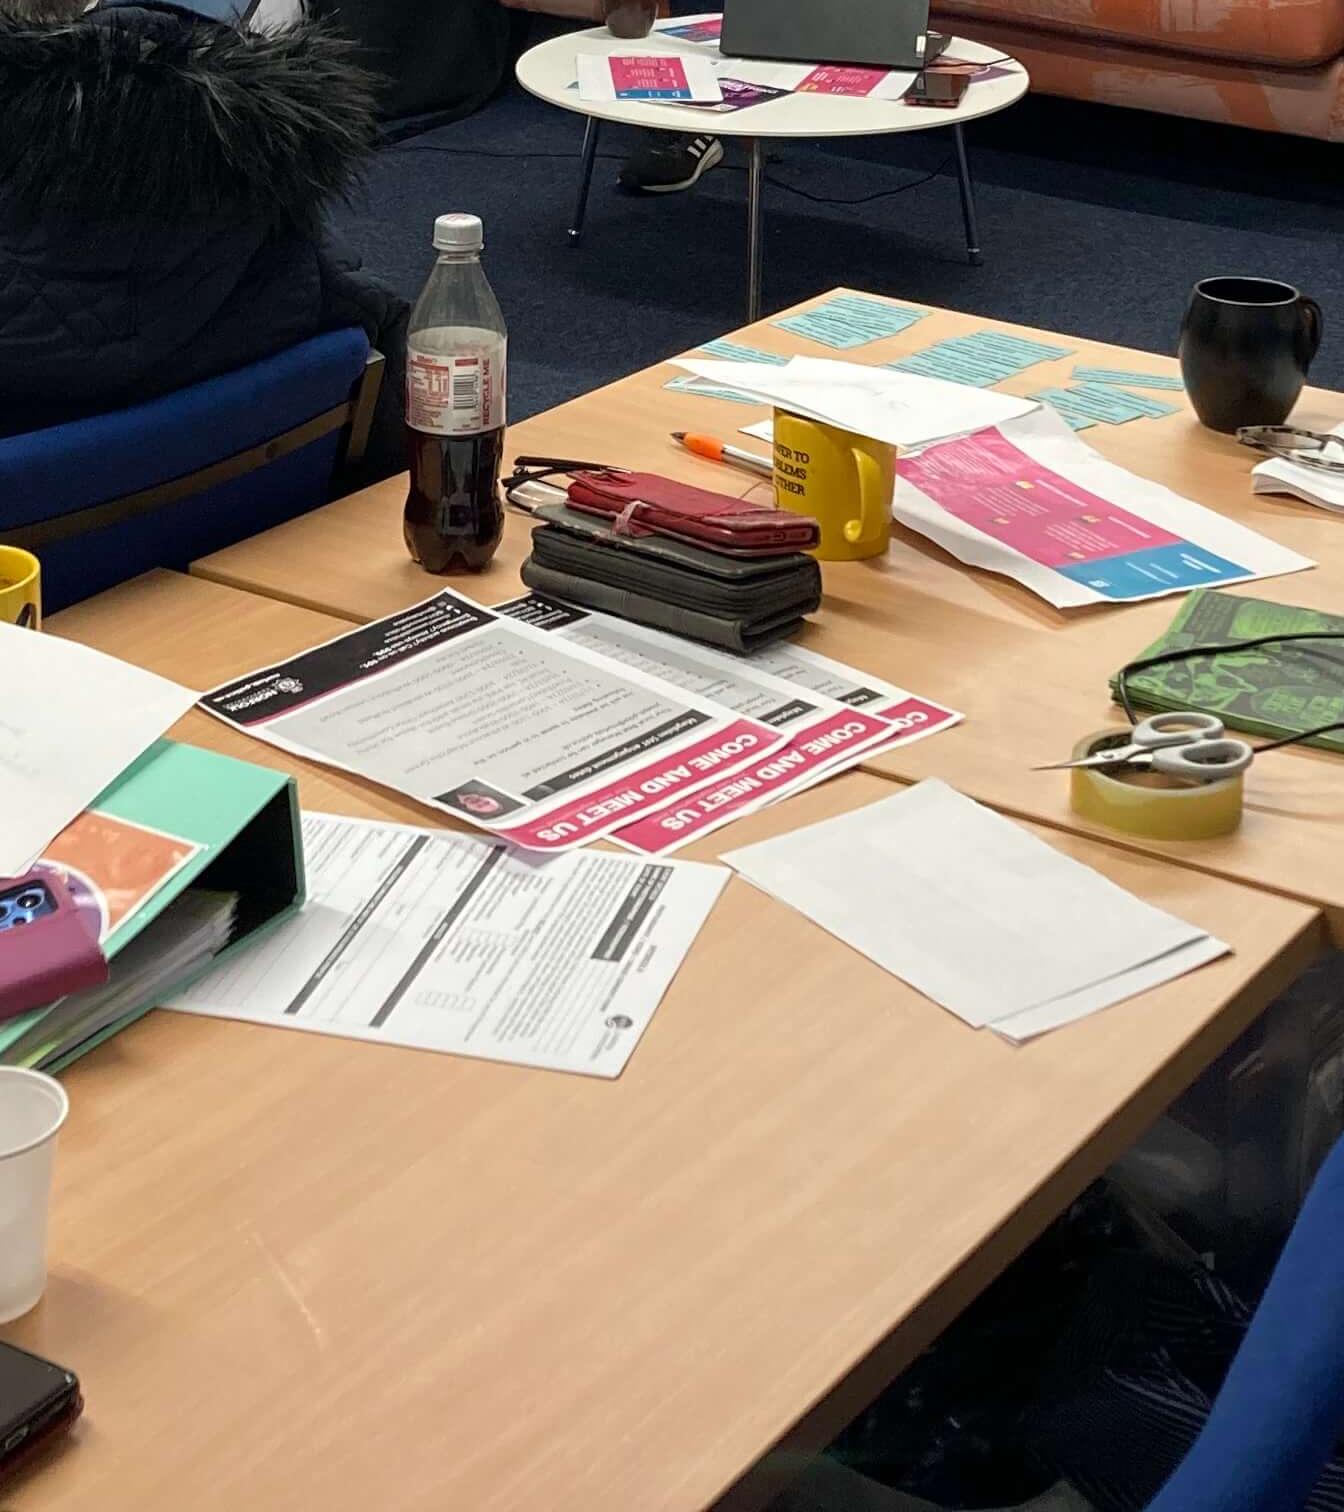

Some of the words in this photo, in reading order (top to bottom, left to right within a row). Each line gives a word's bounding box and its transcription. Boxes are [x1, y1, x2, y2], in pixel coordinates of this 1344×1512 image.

[482, 359, 490, 376] ME
[482, 378, 491, 425] RECYCLE
[793, 450, 810, 464] TO
[688, 733, 760, 771] COME
[805, 721, 868, 756] COME
[591, 742, 642, 771] engagement
[756, 751, 806, 781] AND
[568, 765, 594, 782] dates
[640, 768, 694, 795] AND
[580, 789, 645, 827] MEET
[701, 776, 763, 814] MEET
[537, 821, 578, 842] US
[661, 808, 702, 832] US
